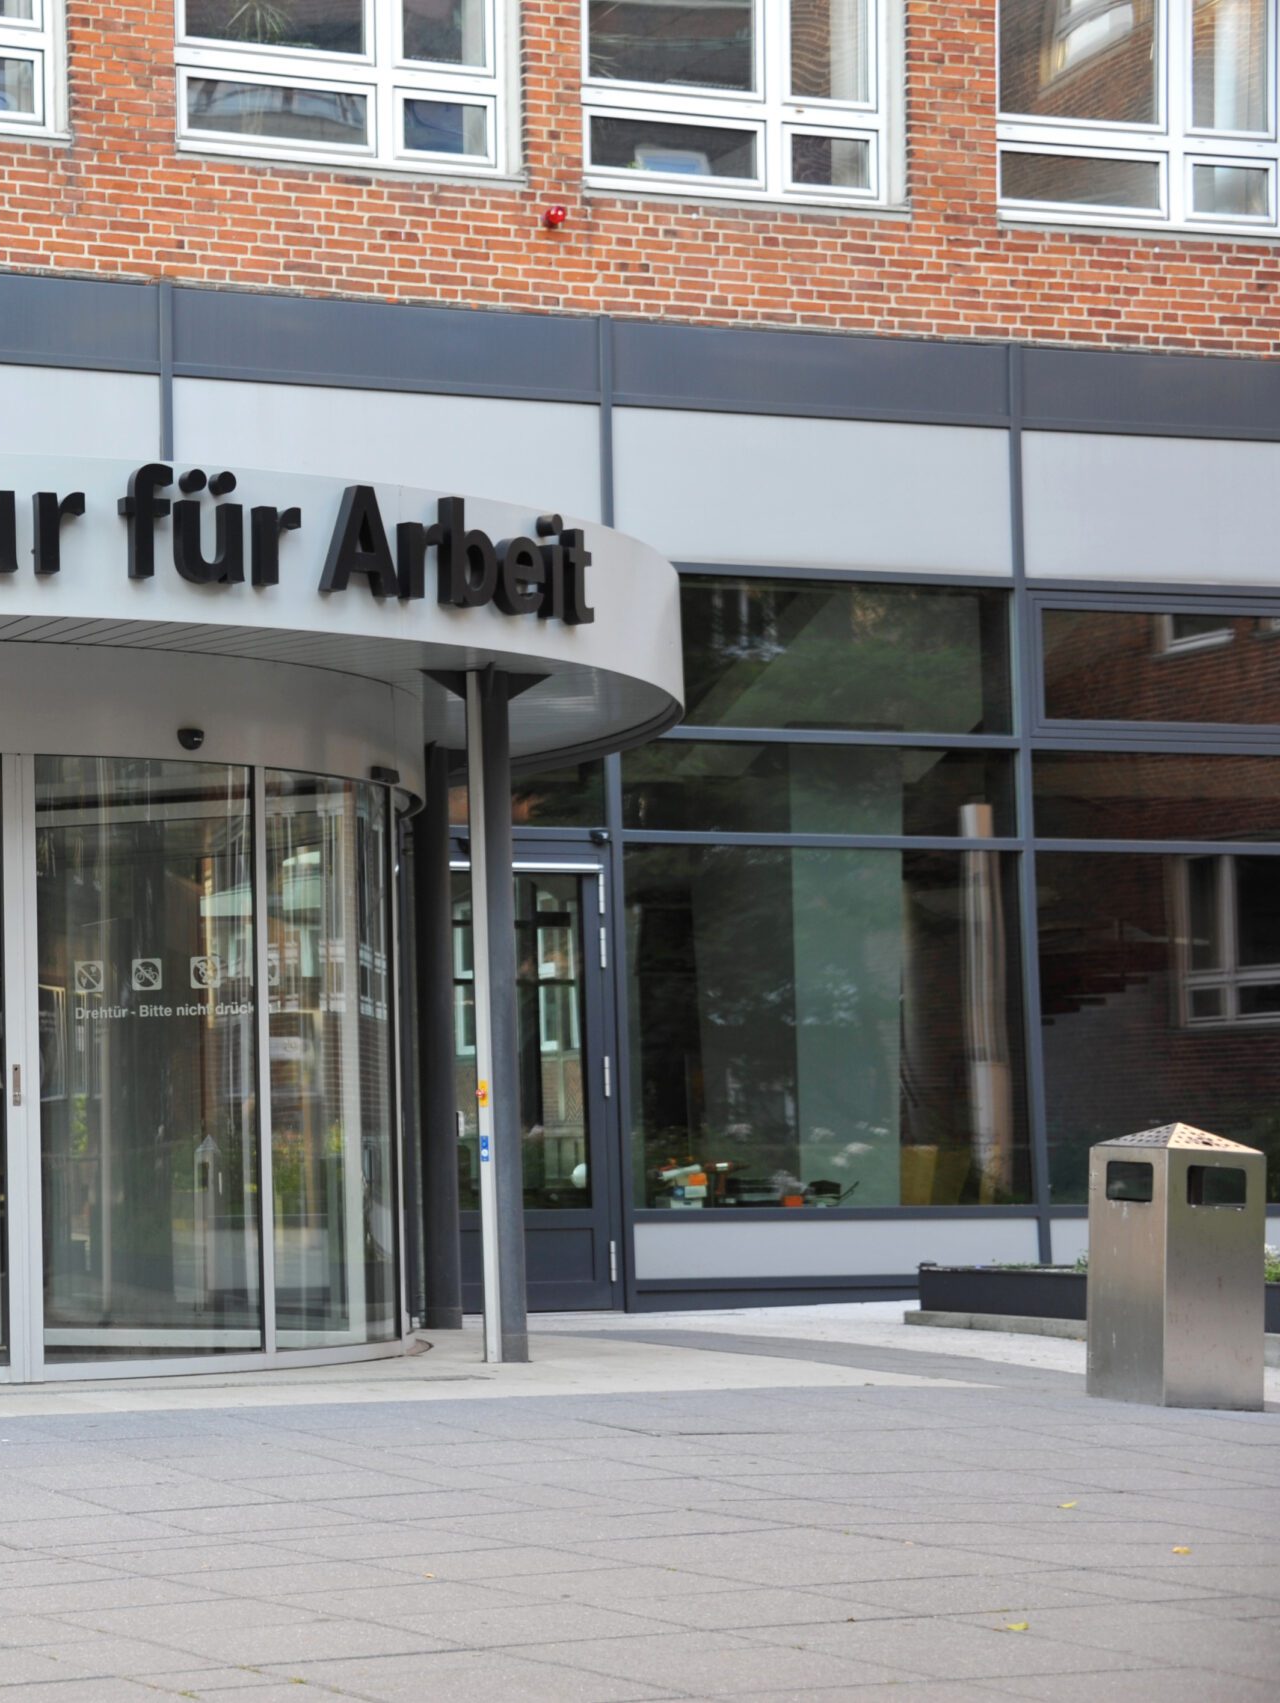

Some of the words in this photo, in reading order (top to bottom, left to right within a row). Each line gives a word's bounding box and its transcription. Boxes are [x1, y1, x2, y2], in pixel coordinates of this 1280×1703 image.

[119, 464, 301, 587] für
[319, 485, 594, 626] Arbeit
[75, 1005, 128, 1020] Drehtür
[139, 1004, 172, 1018] Bitte
[176, 1003, 211, 1016] nicht
